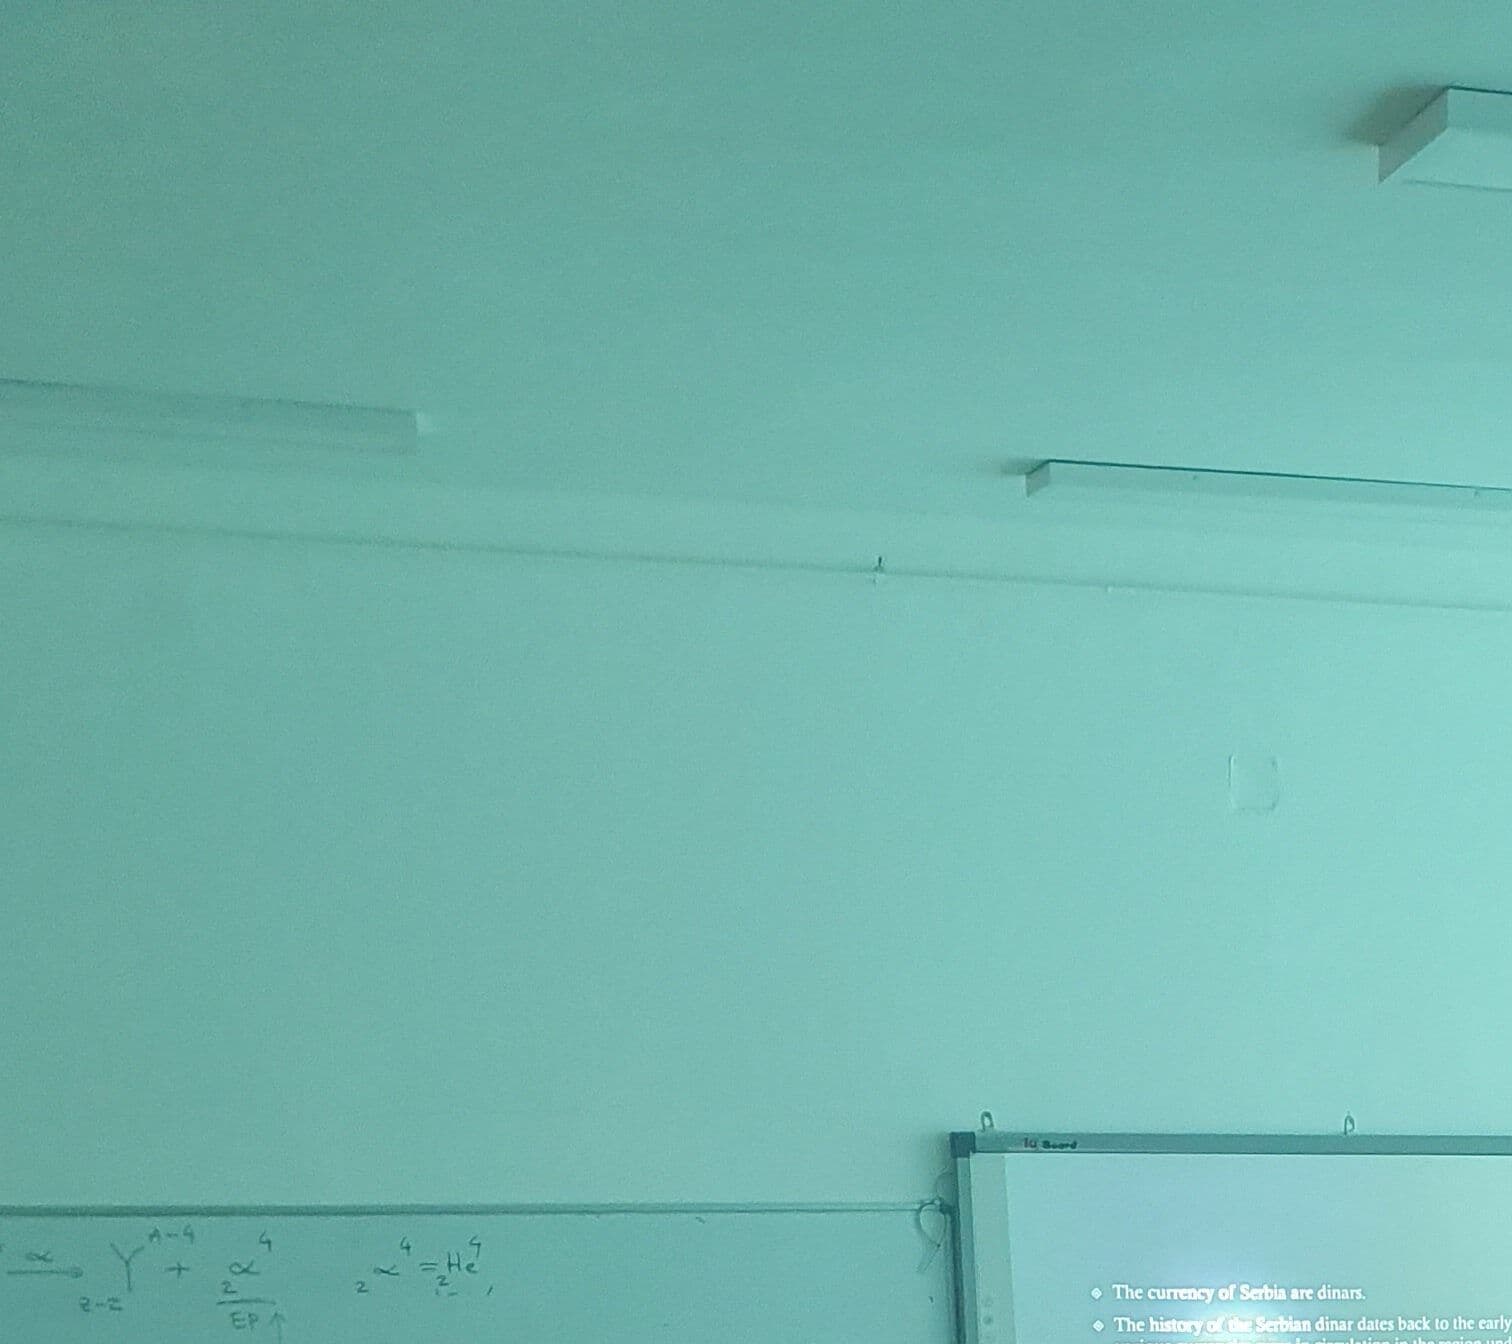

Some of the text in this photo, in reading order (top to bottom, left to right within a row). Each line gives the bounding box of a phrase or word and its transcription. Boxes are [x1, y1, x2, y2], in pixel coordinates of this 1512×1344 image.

[1112, 1284, 1366, 1304] The currency of Serbia are dinars.
[1113, 1317, 1145, 1332] The
[1149, 1316, 1204, 1336] history
[1206, 1316, 1225, 1333] of
[1228, 1316, 1252, 1332] the
[1255, 1315, 1311, 1332] Serbian
[1315, 1316, 1353, 1331] dinar
[1357, 1316, 1394, 1331] dates
[1398, 1316, 1431, 1331] back
[1435, 1318, 1448, 1331] to
[1453, 1315, 1475, 1330] the
[1478, 1315, 1512, 1333] early
